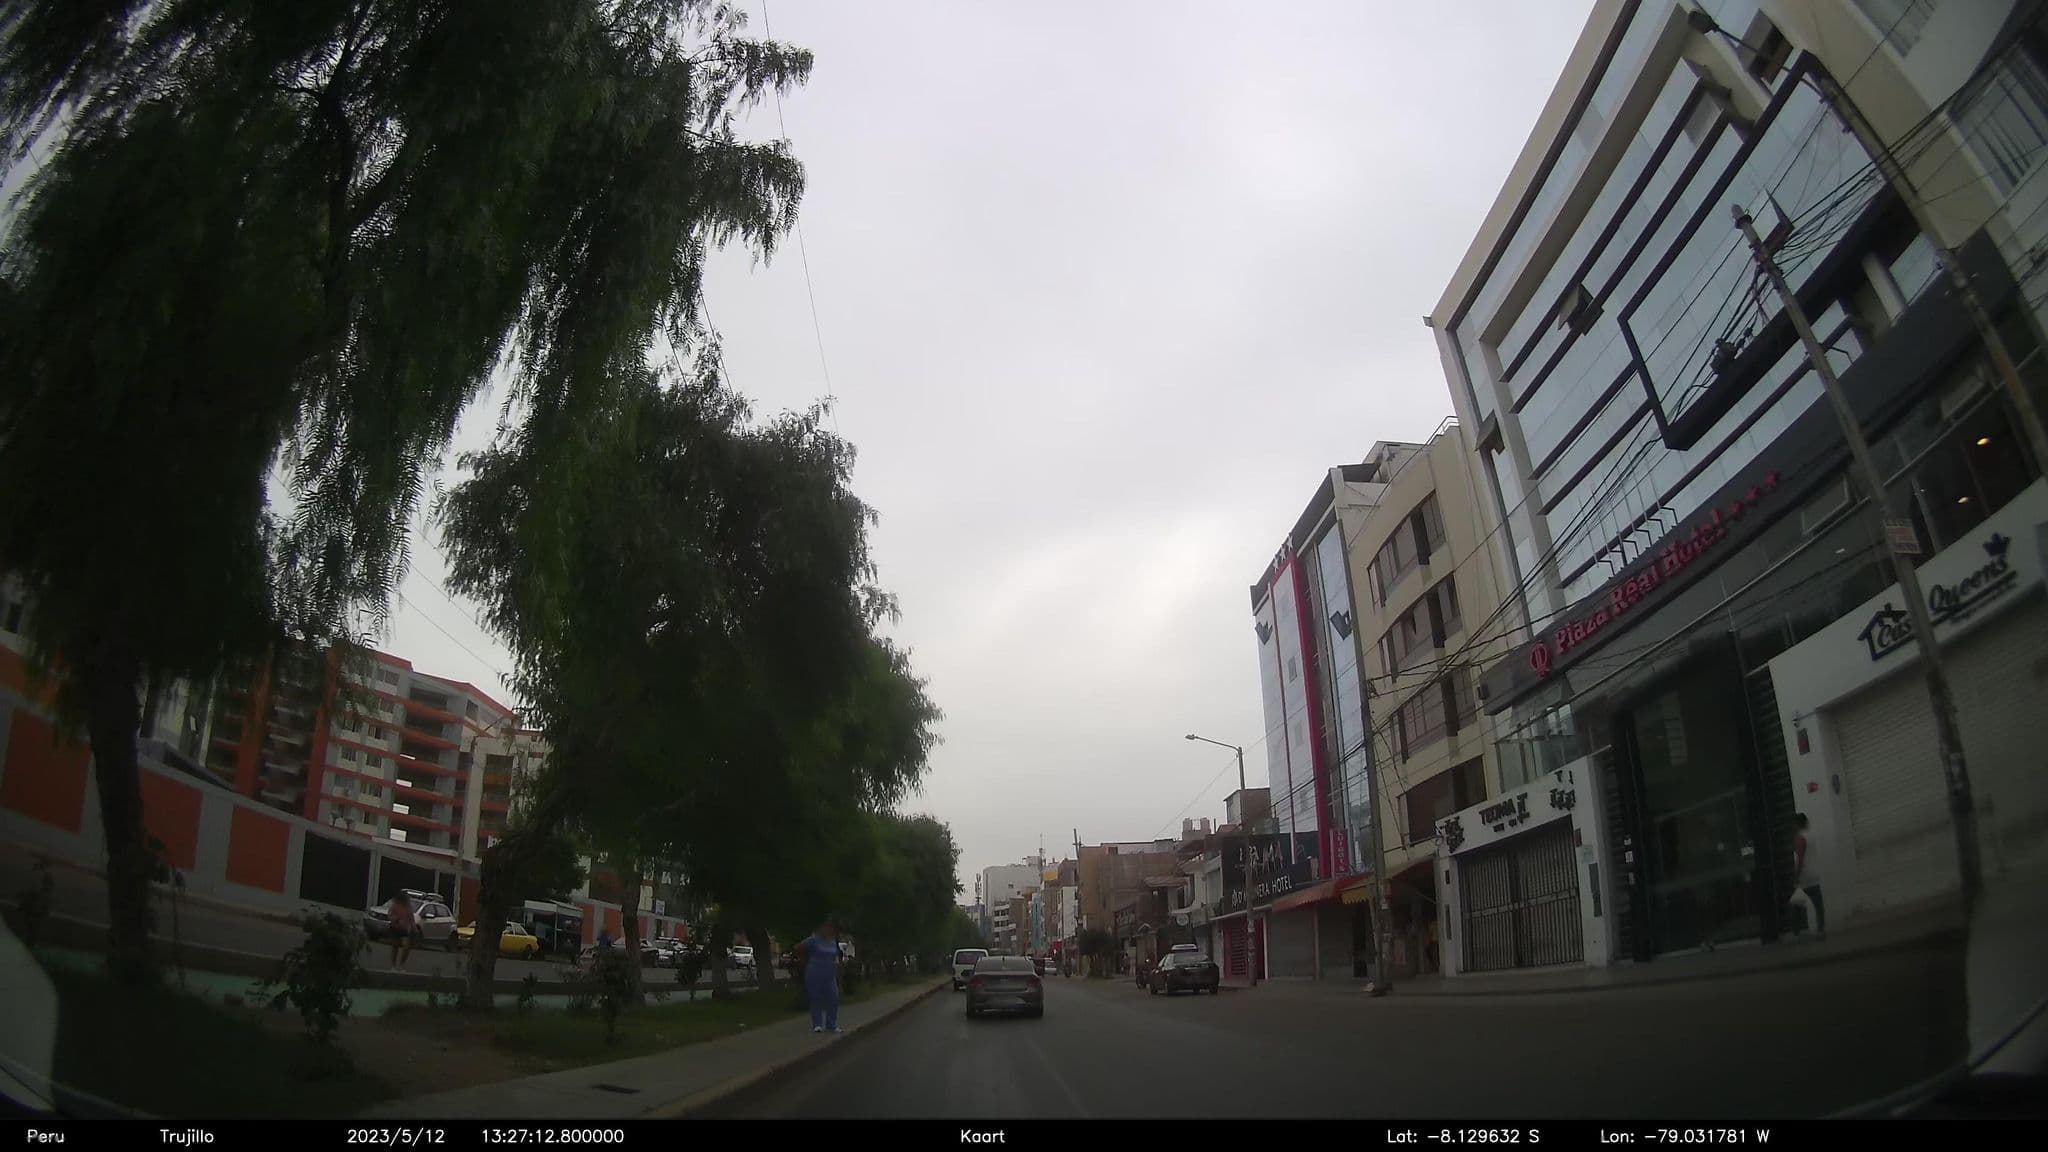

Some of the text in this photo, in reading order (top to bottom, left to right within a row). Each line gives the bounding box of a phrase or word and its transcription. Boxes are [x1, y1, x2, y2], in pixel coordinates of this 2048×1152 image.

[1555, 607, 1608, 652] Plaza
[1610, 569, 1662, 615] Real
[1664, 508, 1728, 577] Hotel
[1929, 558, 2008, 614] Queens
[1271, 874, 1292, 896] HOTEL
